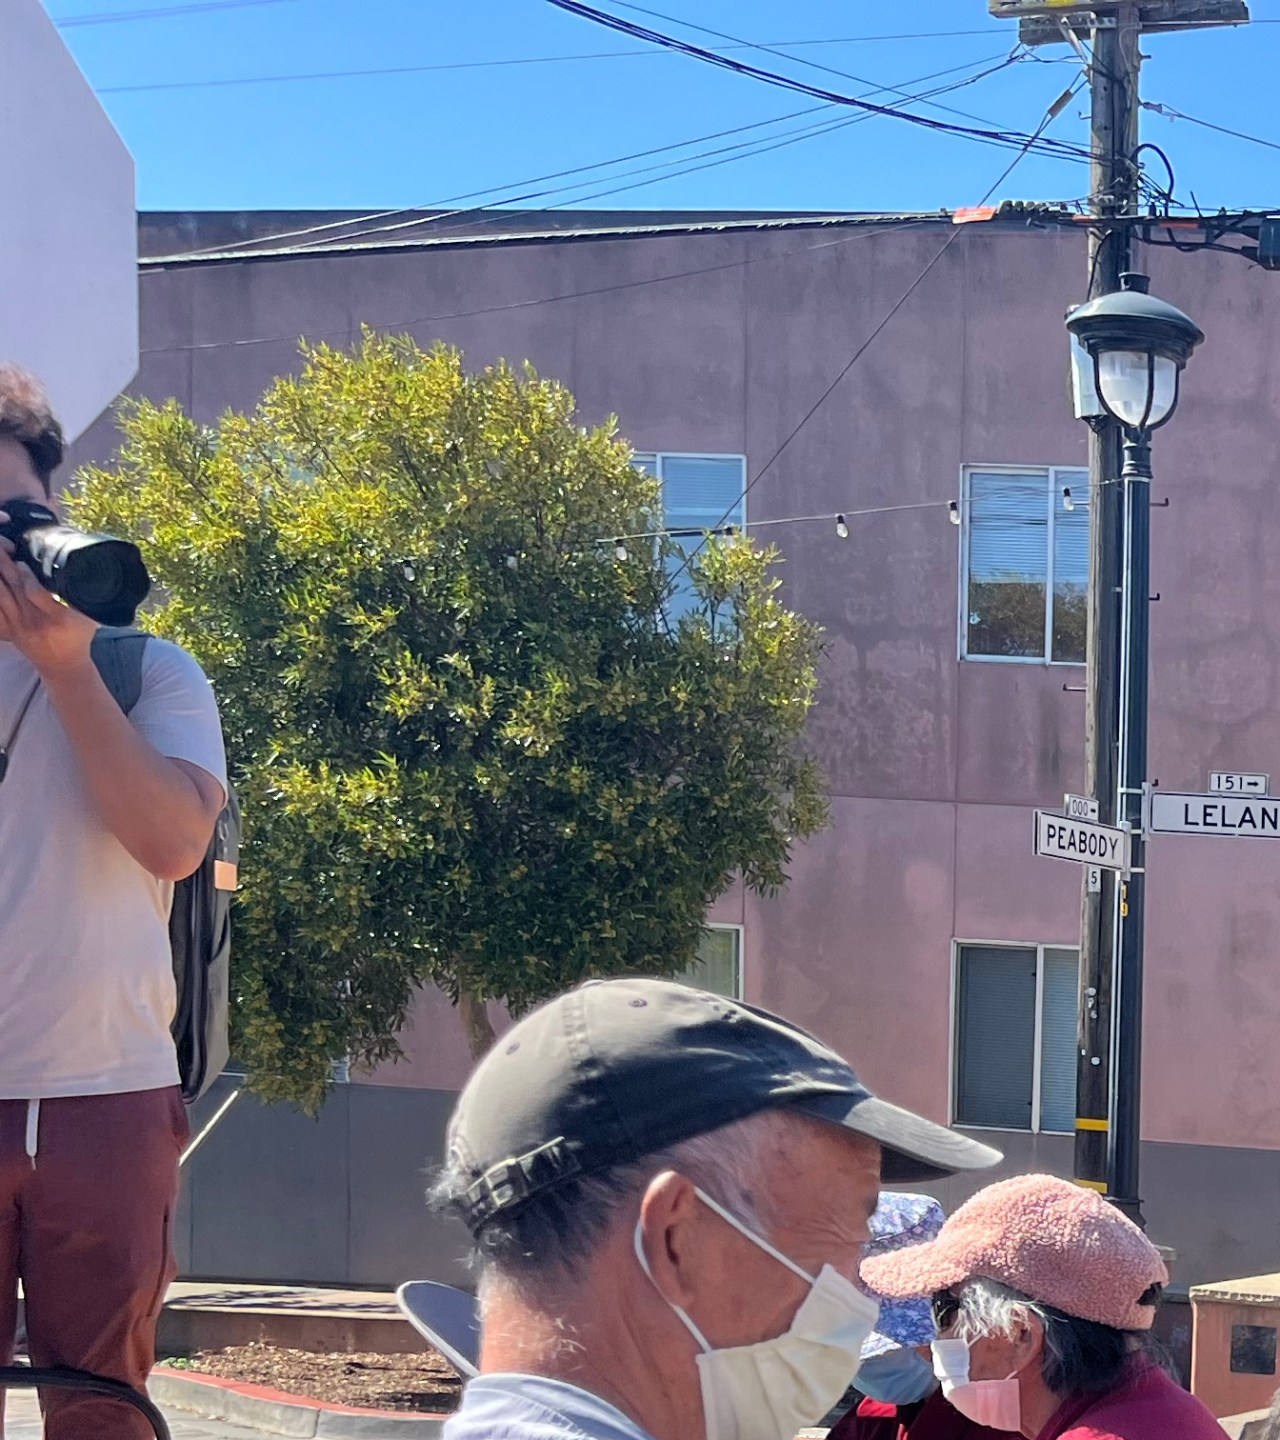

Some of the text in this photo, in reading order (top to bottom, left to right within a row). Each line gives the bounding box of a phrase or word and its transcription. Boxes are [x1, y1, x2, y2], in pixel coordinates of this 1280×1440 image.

[1217, 775, 1243, 790] 151
[1072, 799, 1089, 817] 000
[1047, 823, 1119, 860] PEABODY
[1090, 870, 1098, 885] 5
